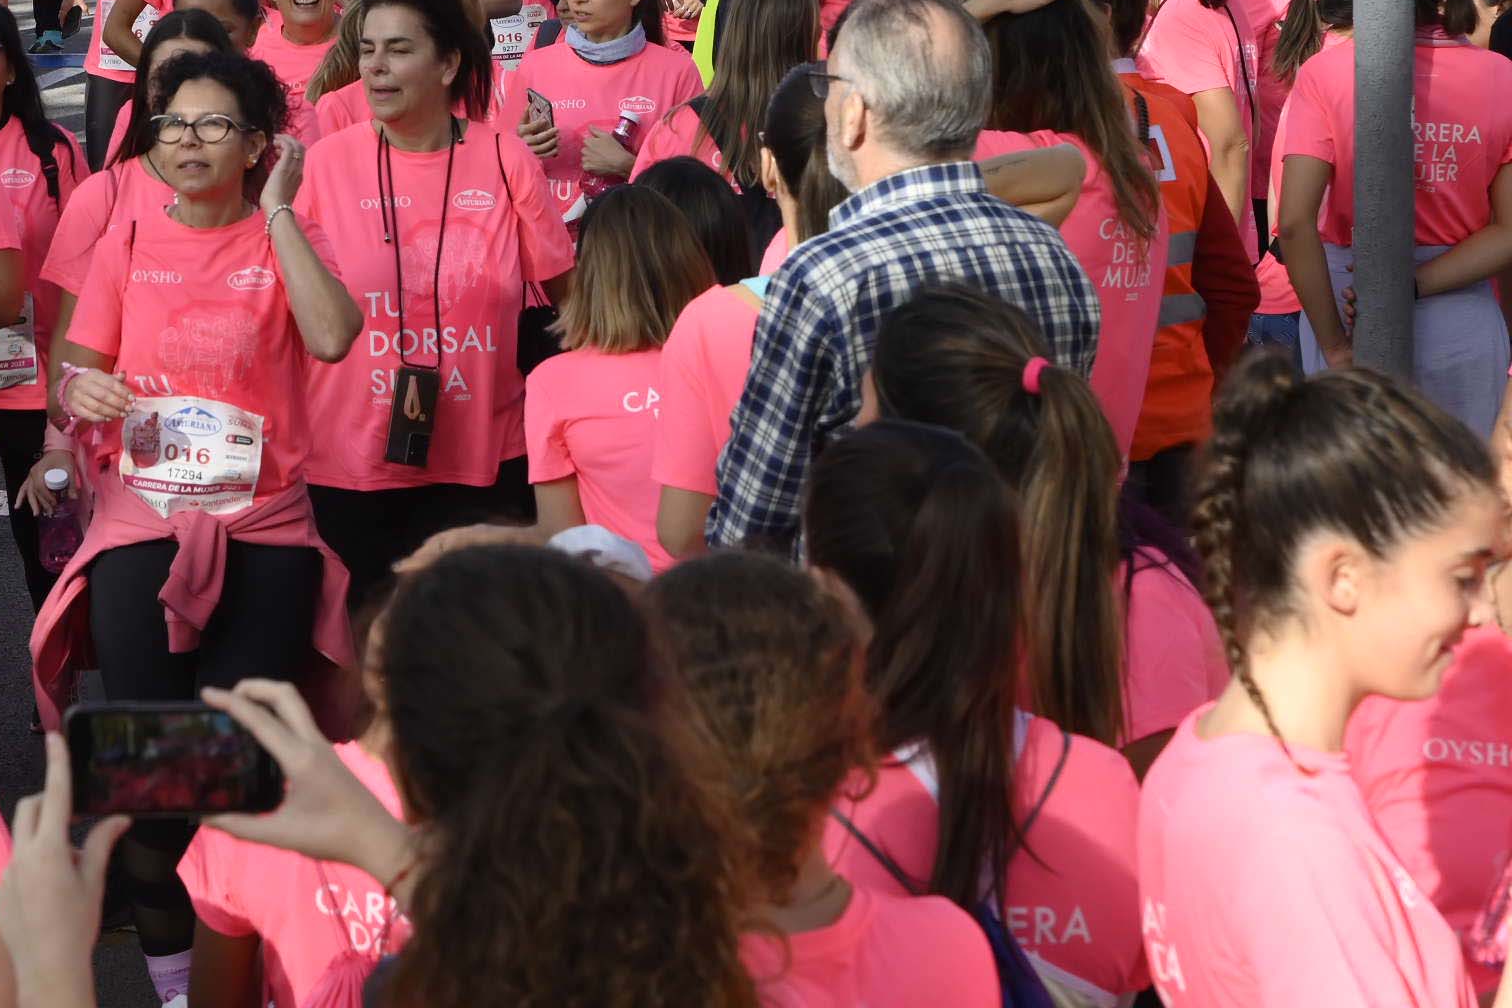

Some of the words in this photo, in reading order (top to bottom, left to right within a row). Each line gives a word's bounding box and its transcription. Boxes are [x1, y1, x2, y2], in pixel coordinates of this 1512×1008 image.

[497, 32, 523, 43] 016
[502, 45, 518, 53] 9277
[1432, 144, 1457, 162] LA
[548, 178, 571, 201] TU
[1112, 242, 1135, 264] DE
[132, 268, 183, 284] OYSHO
[364, 291, 400, 318] TU
[369, 325, 497, 357] DORSAL
[134, 374, 173, 396] TU
[164, 443, 211, 465] 016
[167, 467, 203, 481] 17294
[132, 479, 167, 492] CARRERA
[168, 484, 180, 492] DE
[181, 485, 191, 493] LA
